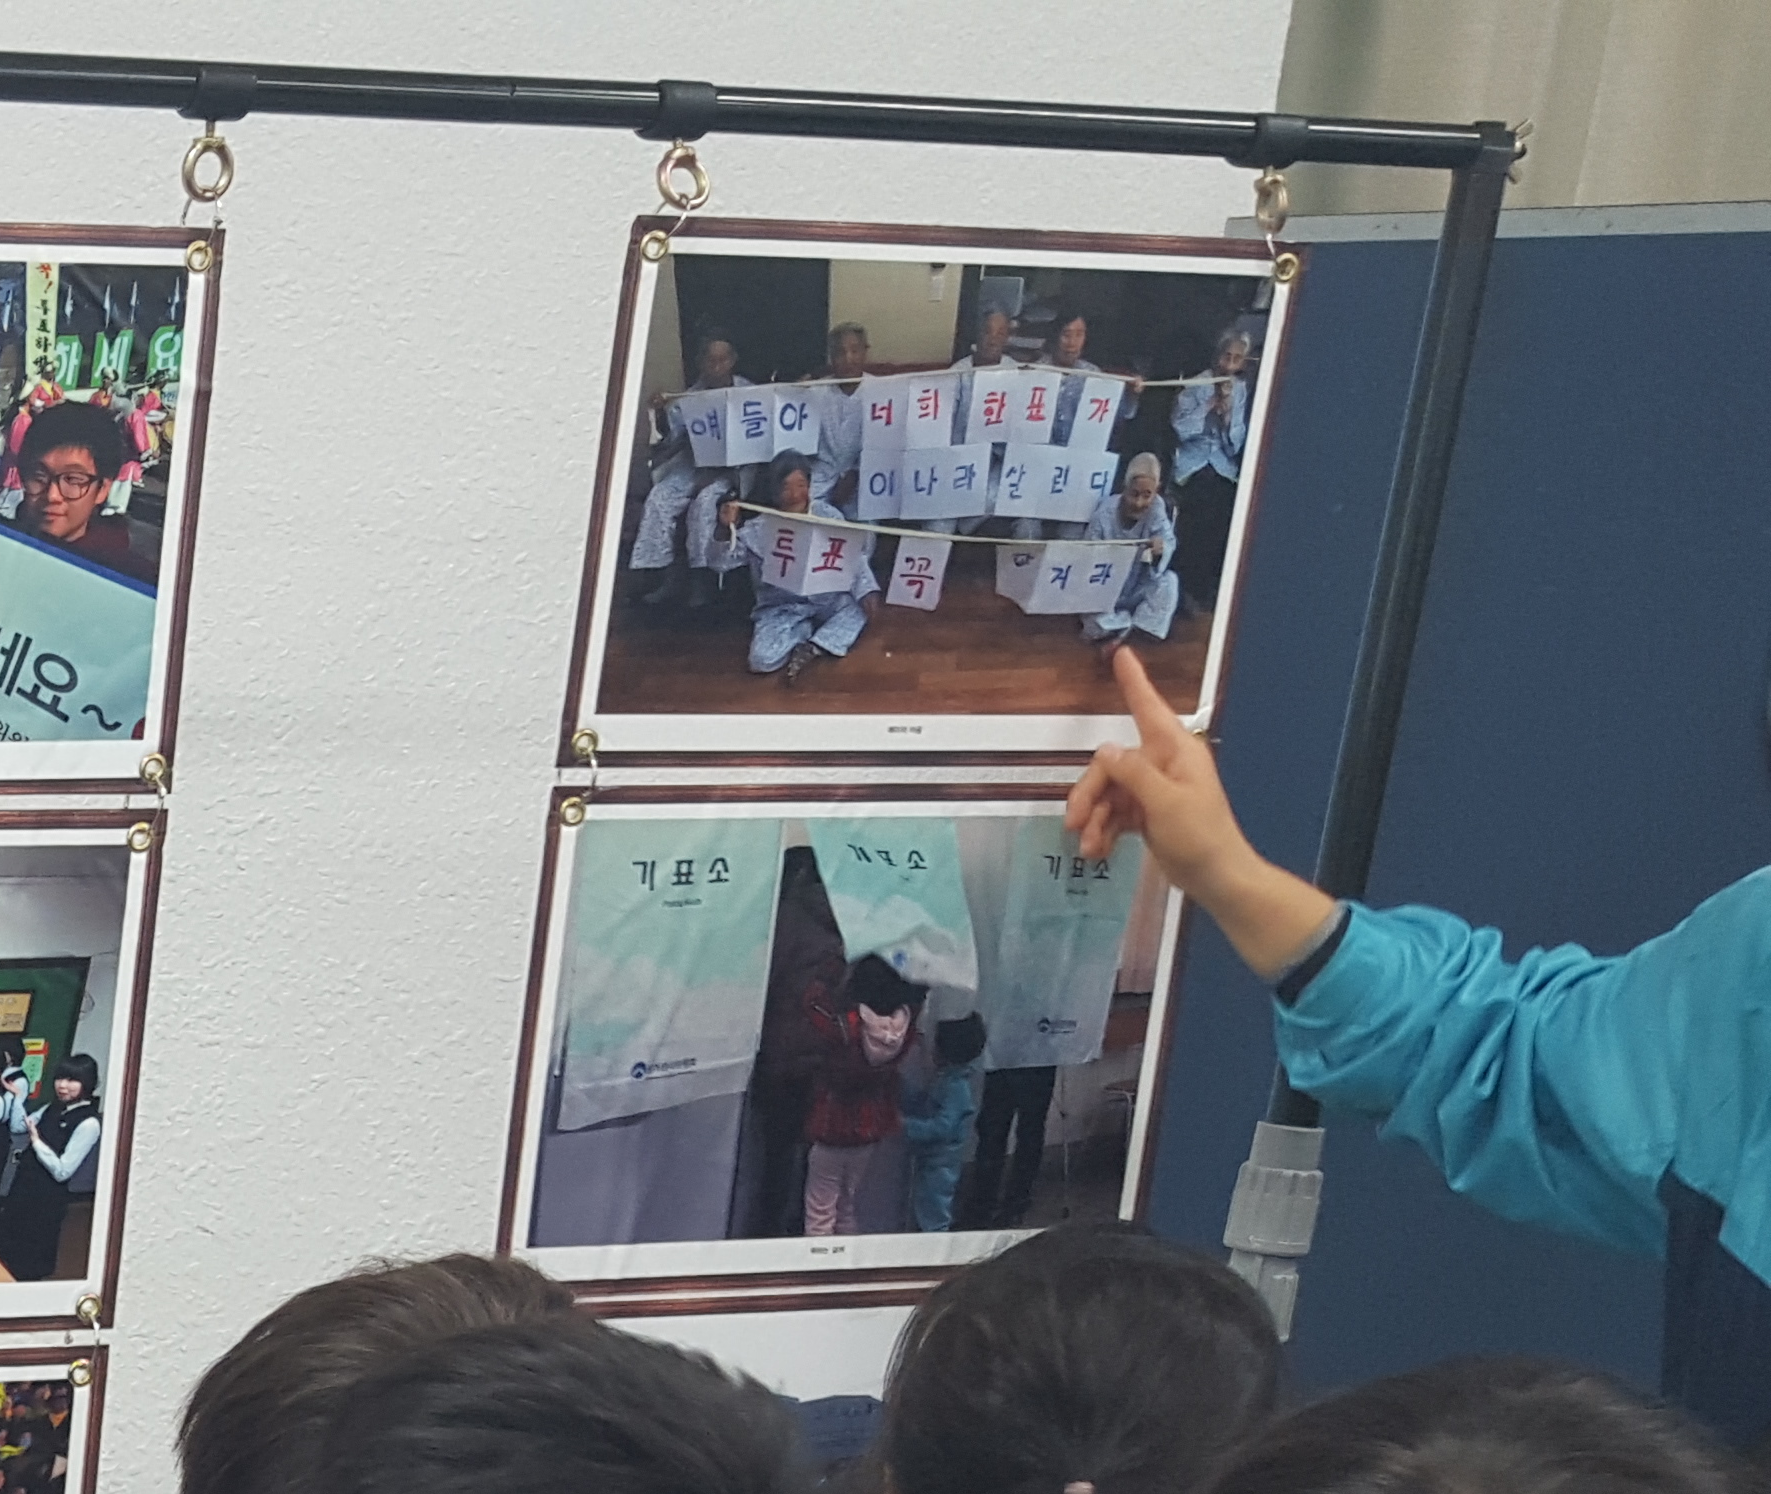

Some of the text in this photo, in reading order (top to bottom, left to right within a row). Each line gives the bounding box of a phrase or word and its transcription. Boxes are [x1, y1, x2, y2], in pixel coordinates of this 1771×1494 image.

[771, 528, 844, 578] 투표
[899, 557, 934, 599] 꼭
[631, 857, 730, 891] 기표소
